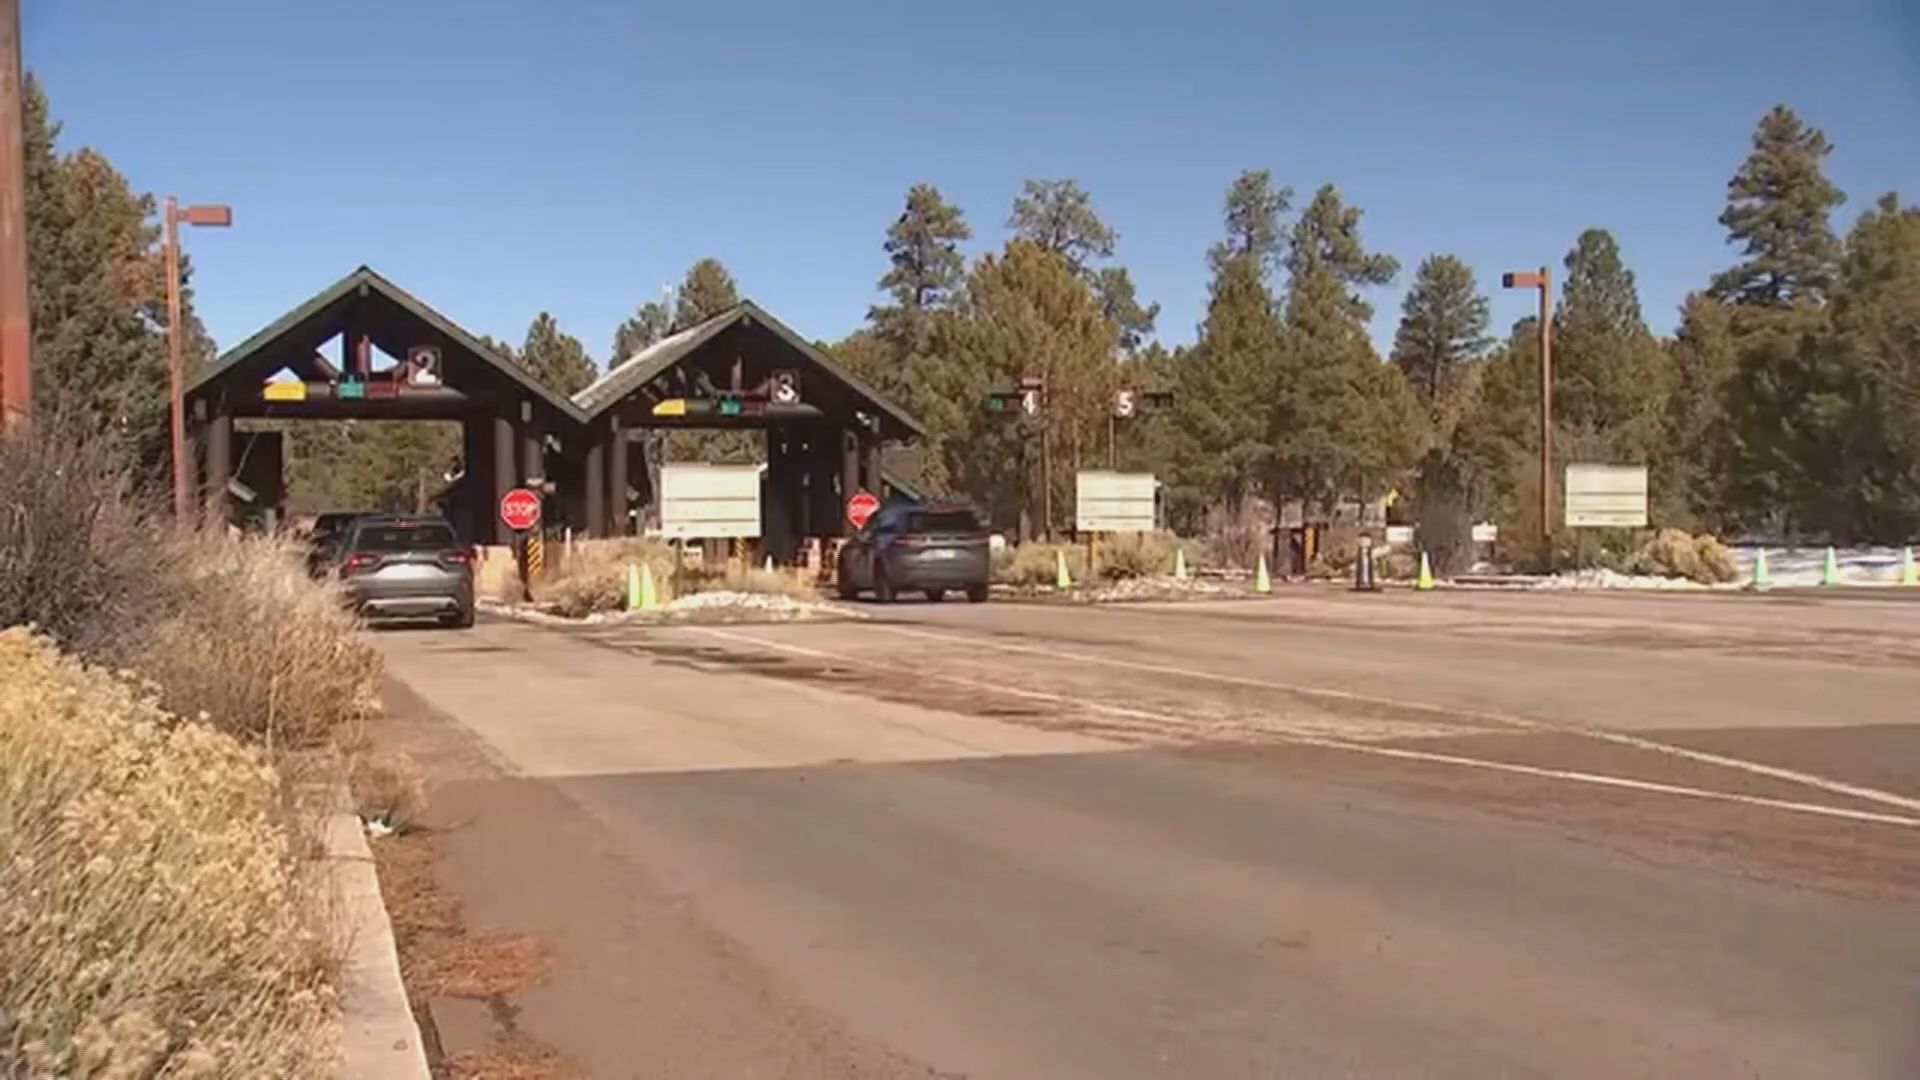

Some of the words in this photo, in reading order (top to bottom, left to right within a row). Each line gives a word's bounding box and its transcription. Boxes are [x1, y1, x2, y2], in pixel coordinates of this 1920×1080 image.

[415, 352, 436, 382] 2
[778, 373, 796, 401] 3
[1022, 391, 1037, 414] 4
[1118, 391, 1133, 415] 5
[505, 501, 536, 517] STOP
